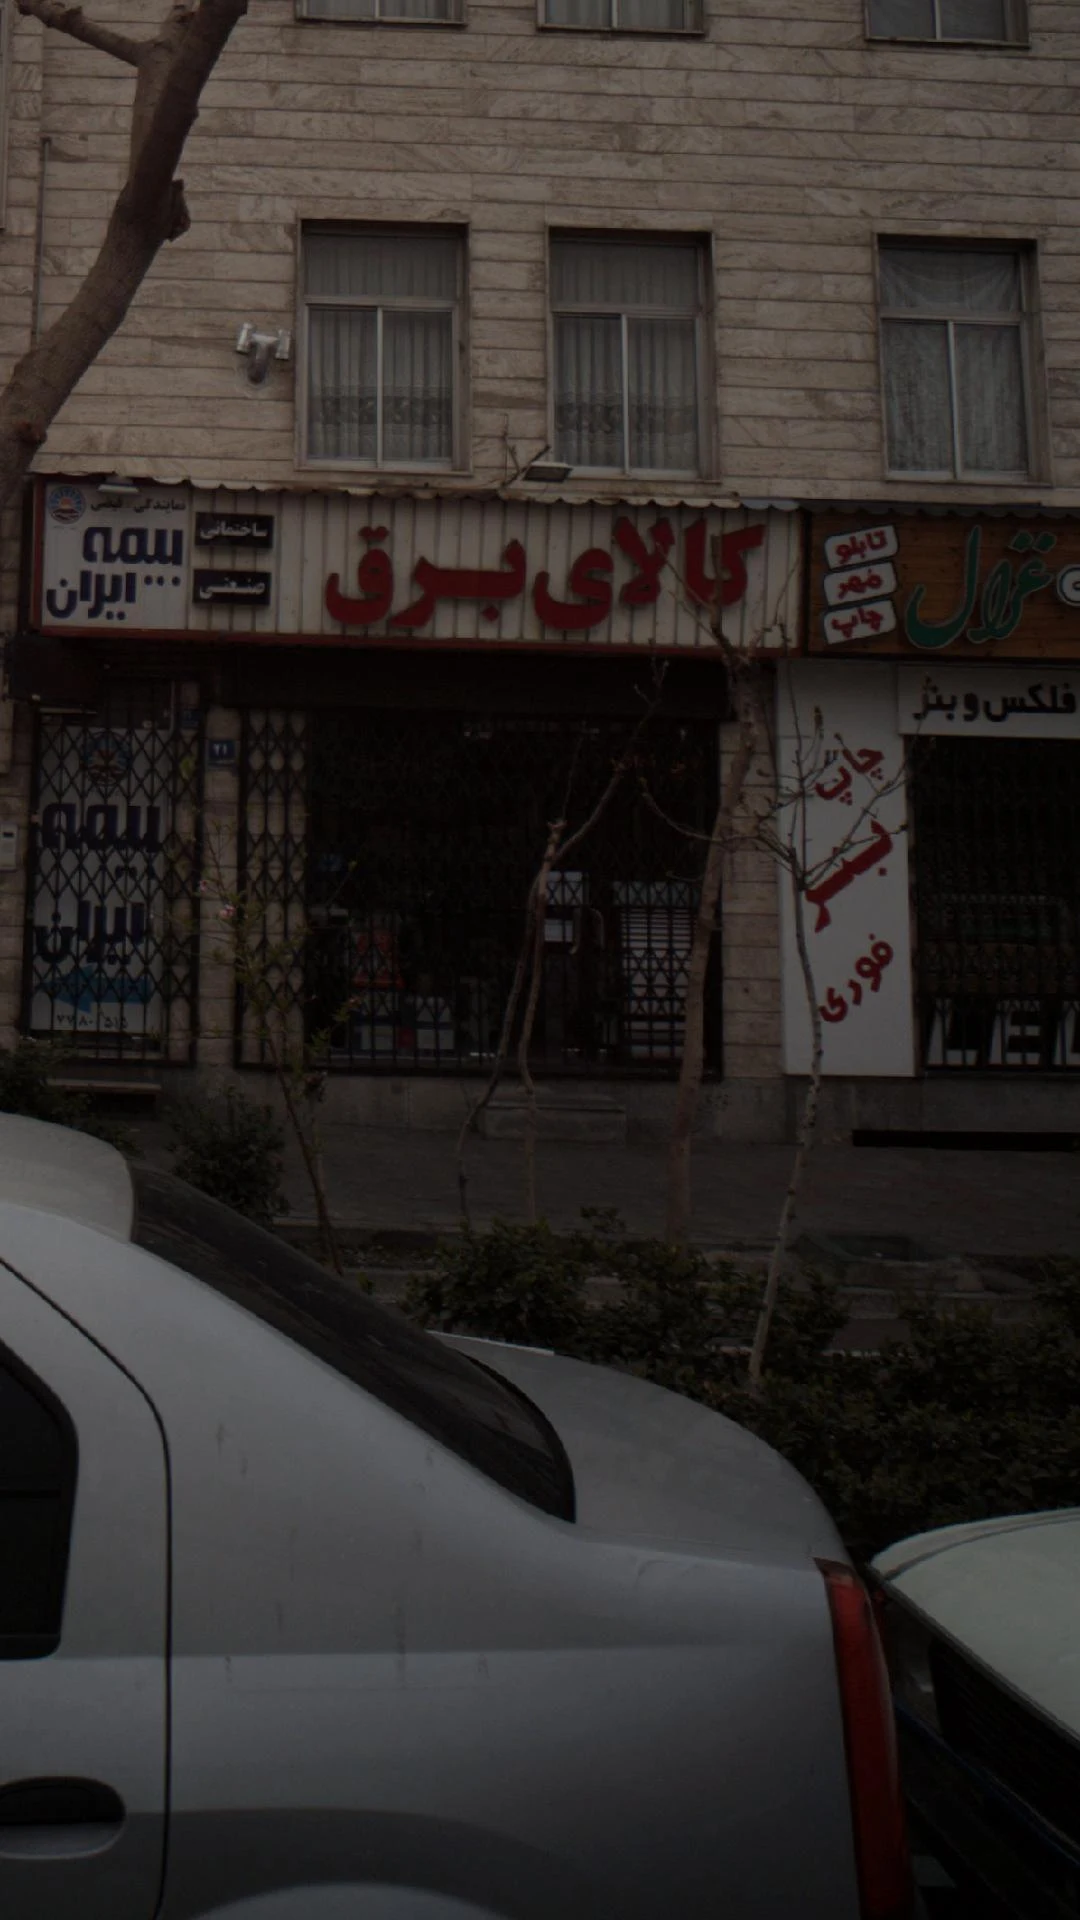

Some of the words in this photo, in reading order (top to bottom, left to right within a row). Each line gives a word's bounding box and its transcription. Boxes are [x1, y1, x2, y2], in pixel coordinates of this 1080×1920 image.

[200, 520, 268, 540] ساختمانی
[836, 530, 887, 564] تابلو
[83, 526, 184, 587] بیمه
[325, 525, 527, 627] برق
[534, 516, 765, 631] کالای
[46, 570, 137, 620] ایران
[199, 577, 266, 600] صنعتی
[831, 607, 883, 638] چاپ
[963, 692, 979, 722] و
[983, 681, 1076, 722] فلکس
[815, 749, 884, 805] چاپ
[819, 933, 893, 1022] فوری
